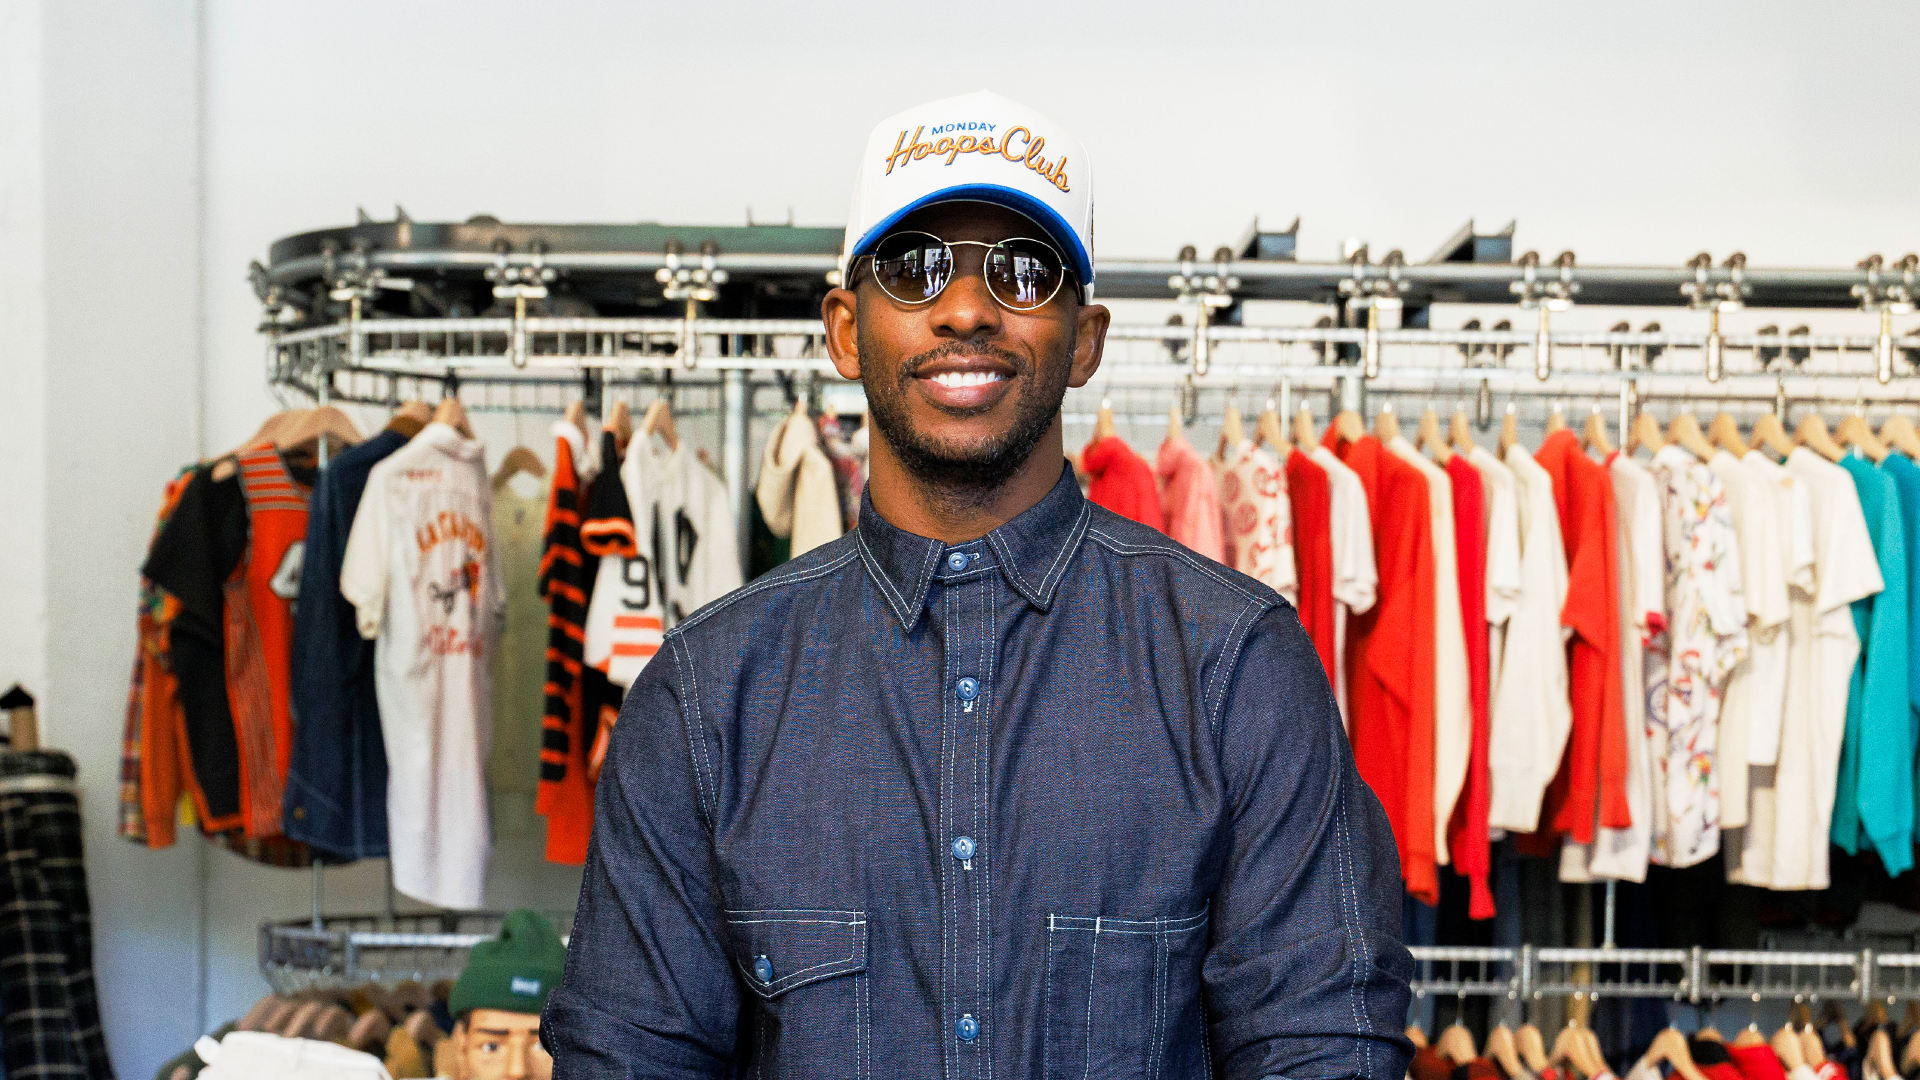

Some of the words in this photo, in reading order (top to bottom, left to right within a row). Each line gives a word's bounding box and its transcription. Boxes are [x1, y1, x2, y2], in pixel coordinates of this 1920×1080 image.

[931, 121, 996, 135] MONDAY
[885, 125, 999, 176] Hoops
[999, 125, 1070, 193] Club
[622, 556, 650, 610] 9
